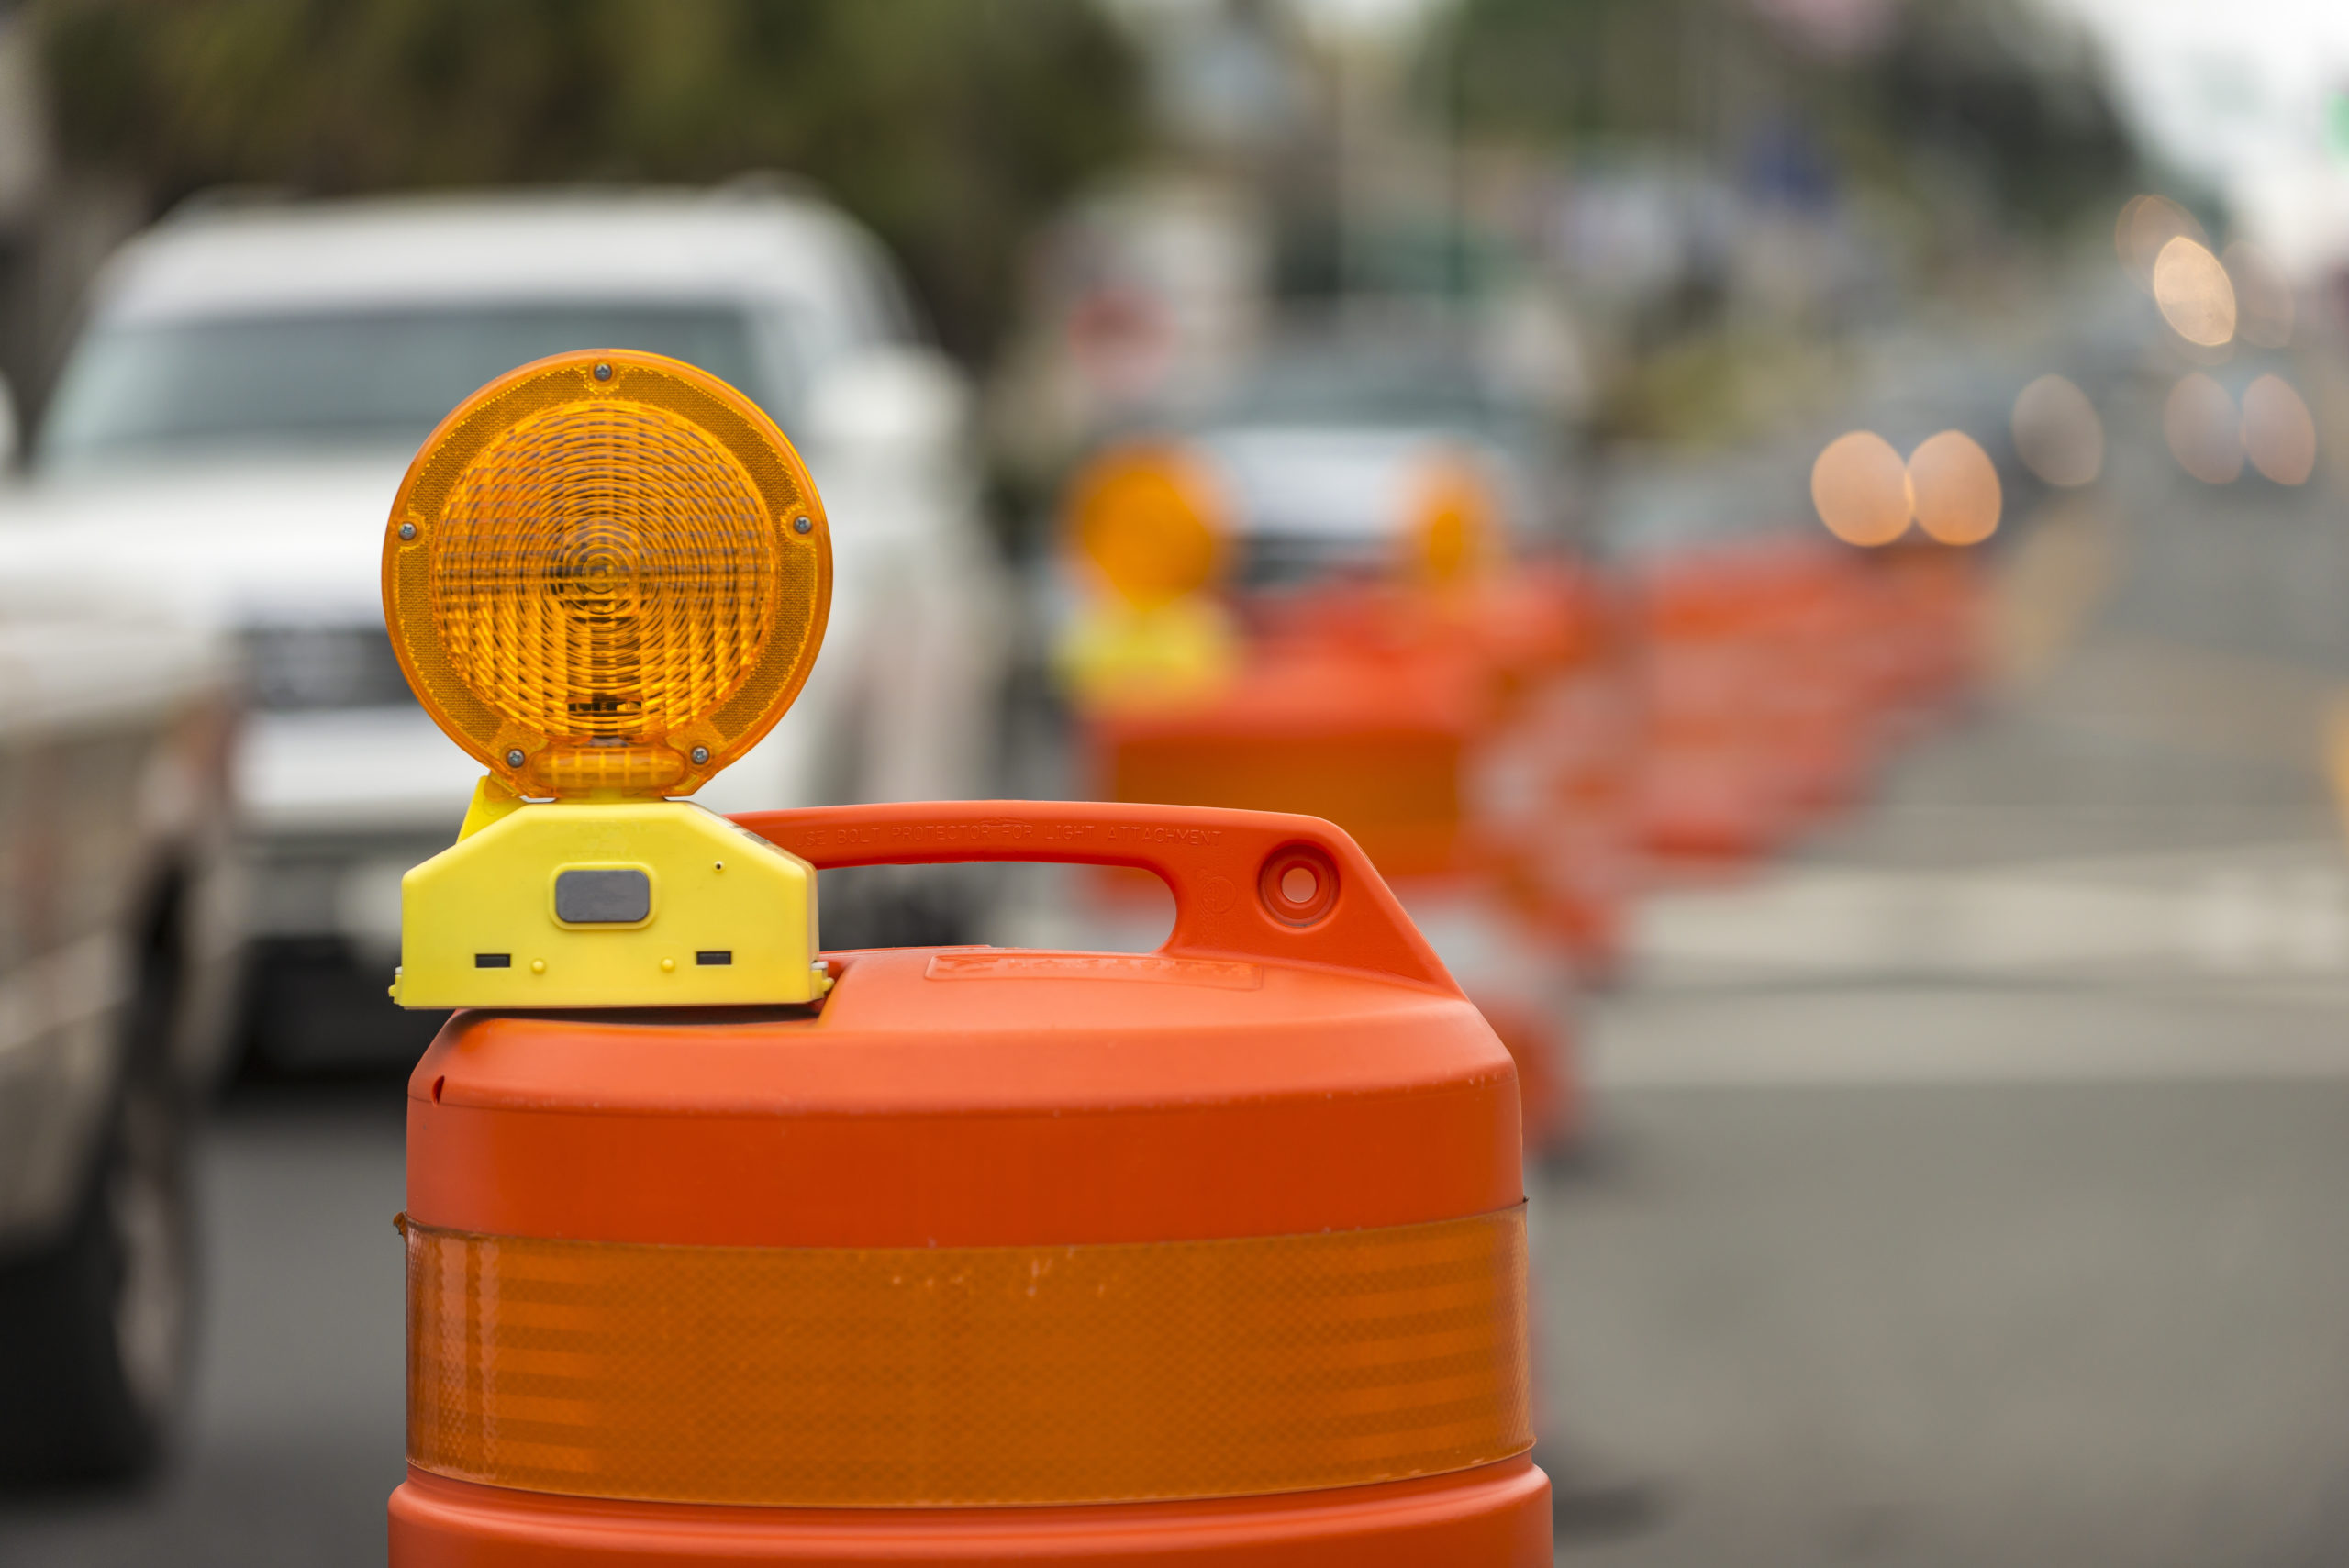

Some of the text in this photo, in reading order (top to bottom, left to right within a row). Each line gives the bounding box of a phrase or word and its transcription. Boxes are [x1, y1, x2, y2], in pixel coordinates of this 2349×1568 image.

[836, 828, 880, 845] BOLT
[891, 824, 992, 841] PROTECTOR
[1002, 824, 1033, 840] FOR
[1043, 825, 1095, 840] LIGHT
[1107, 826, 1222, 846] ATTACHMENT
